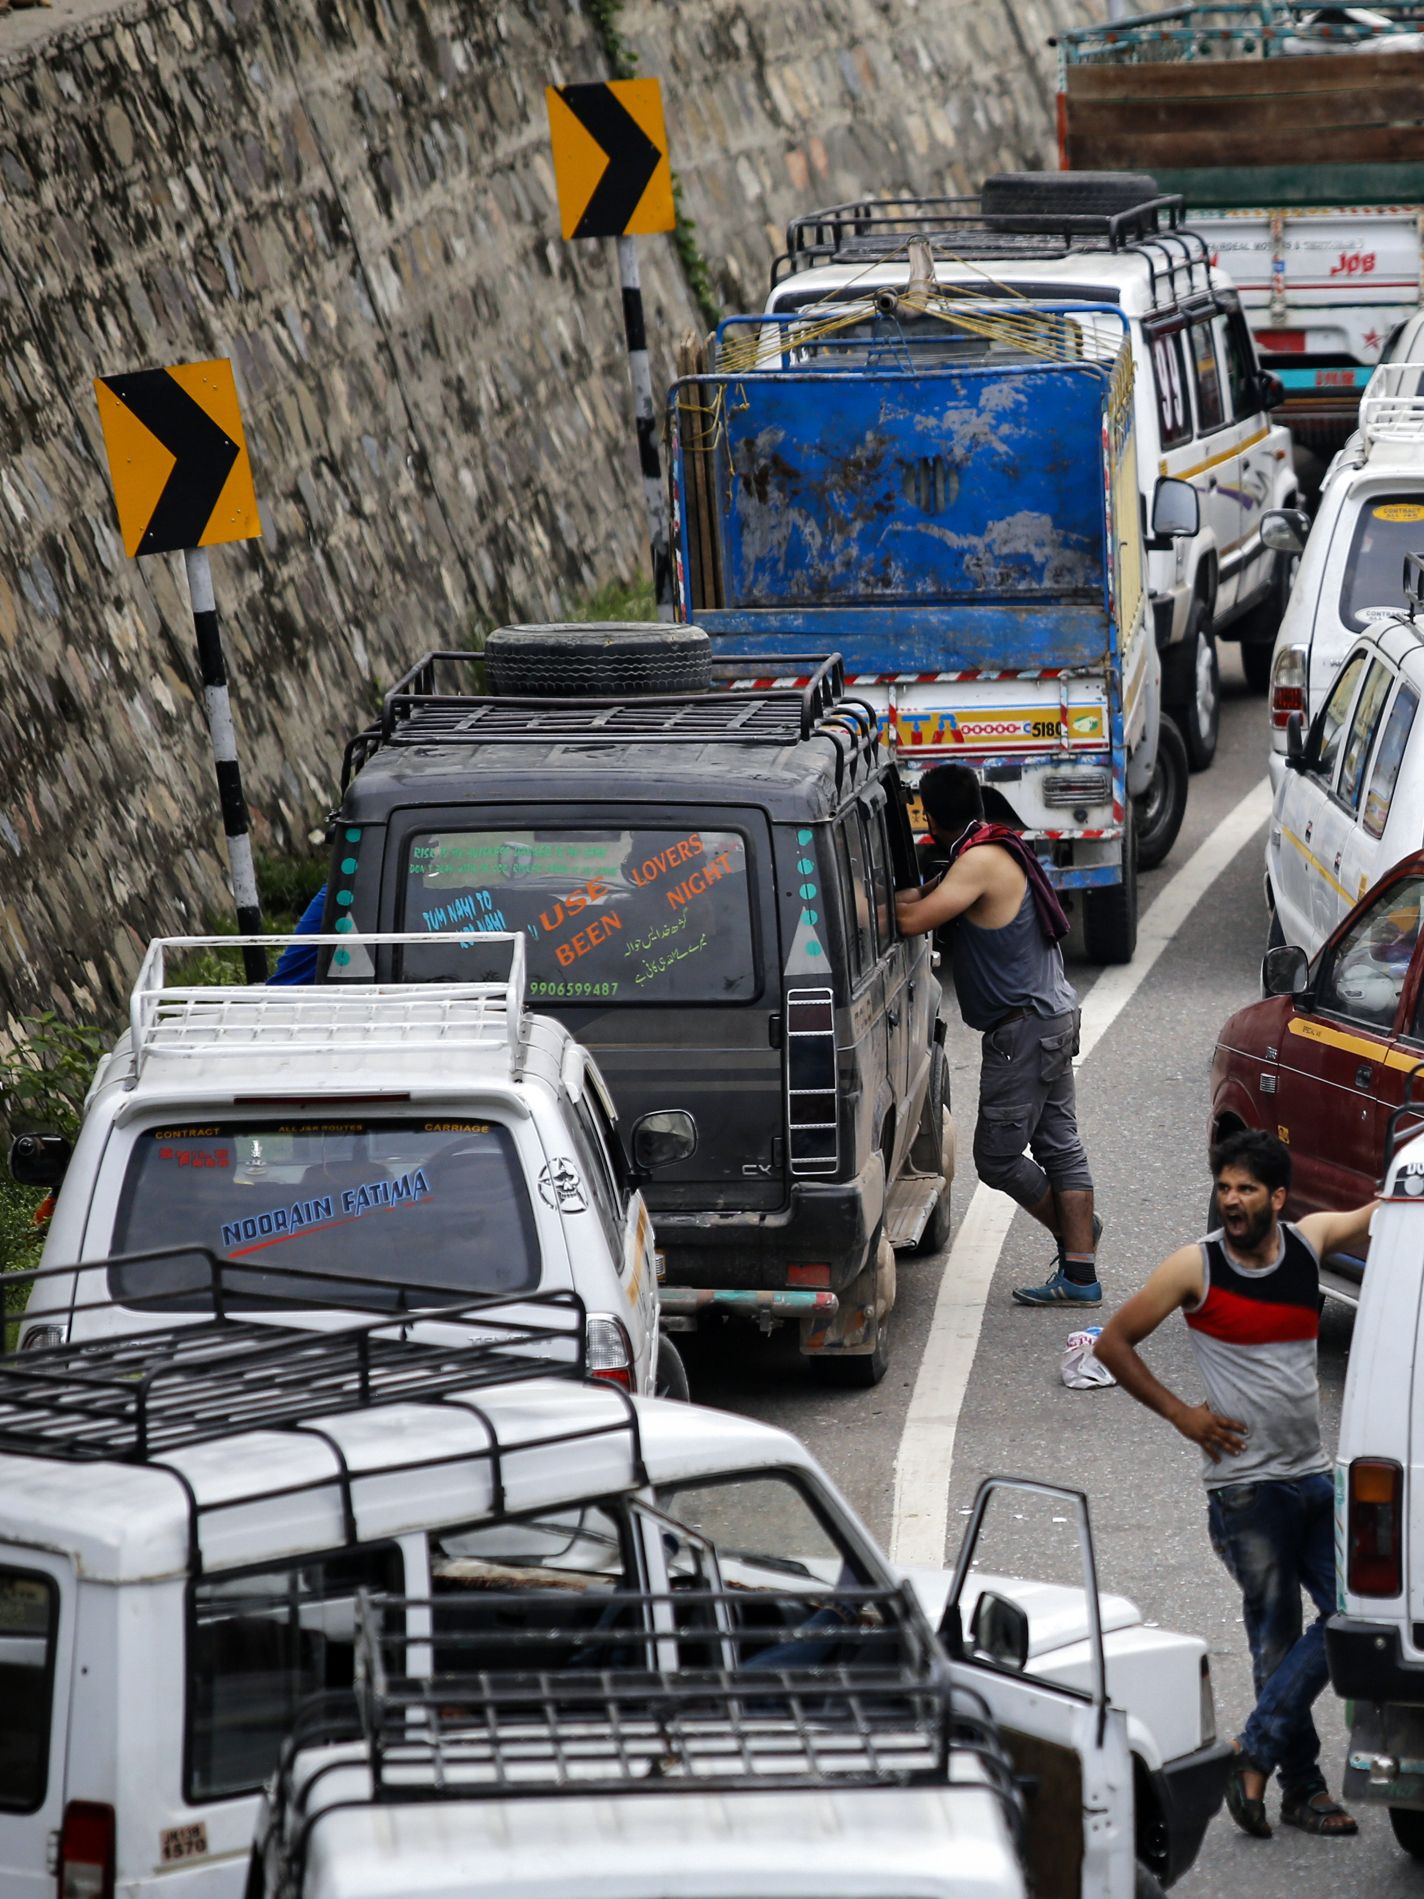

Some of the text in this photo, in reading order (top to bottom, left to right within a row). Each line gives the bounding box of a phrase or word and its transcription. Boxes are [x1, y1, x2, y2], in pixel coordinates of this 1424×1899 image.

[538, 833, 705, 932] USE LOVERS
[555, 850, 734, 968] BEEN NIGHT
[530, 982, 619, 997] 9906599487
[155, 1127, 221, 1140] CONTRACT
[278, 1124, 298, 1133] ALL
[323, 1124, 364, 1133] ROUTES
[424, 1123, 490, 1134] CARRIAGE
[221, 1168, 431, 1247] NOORAIN FATIMA
